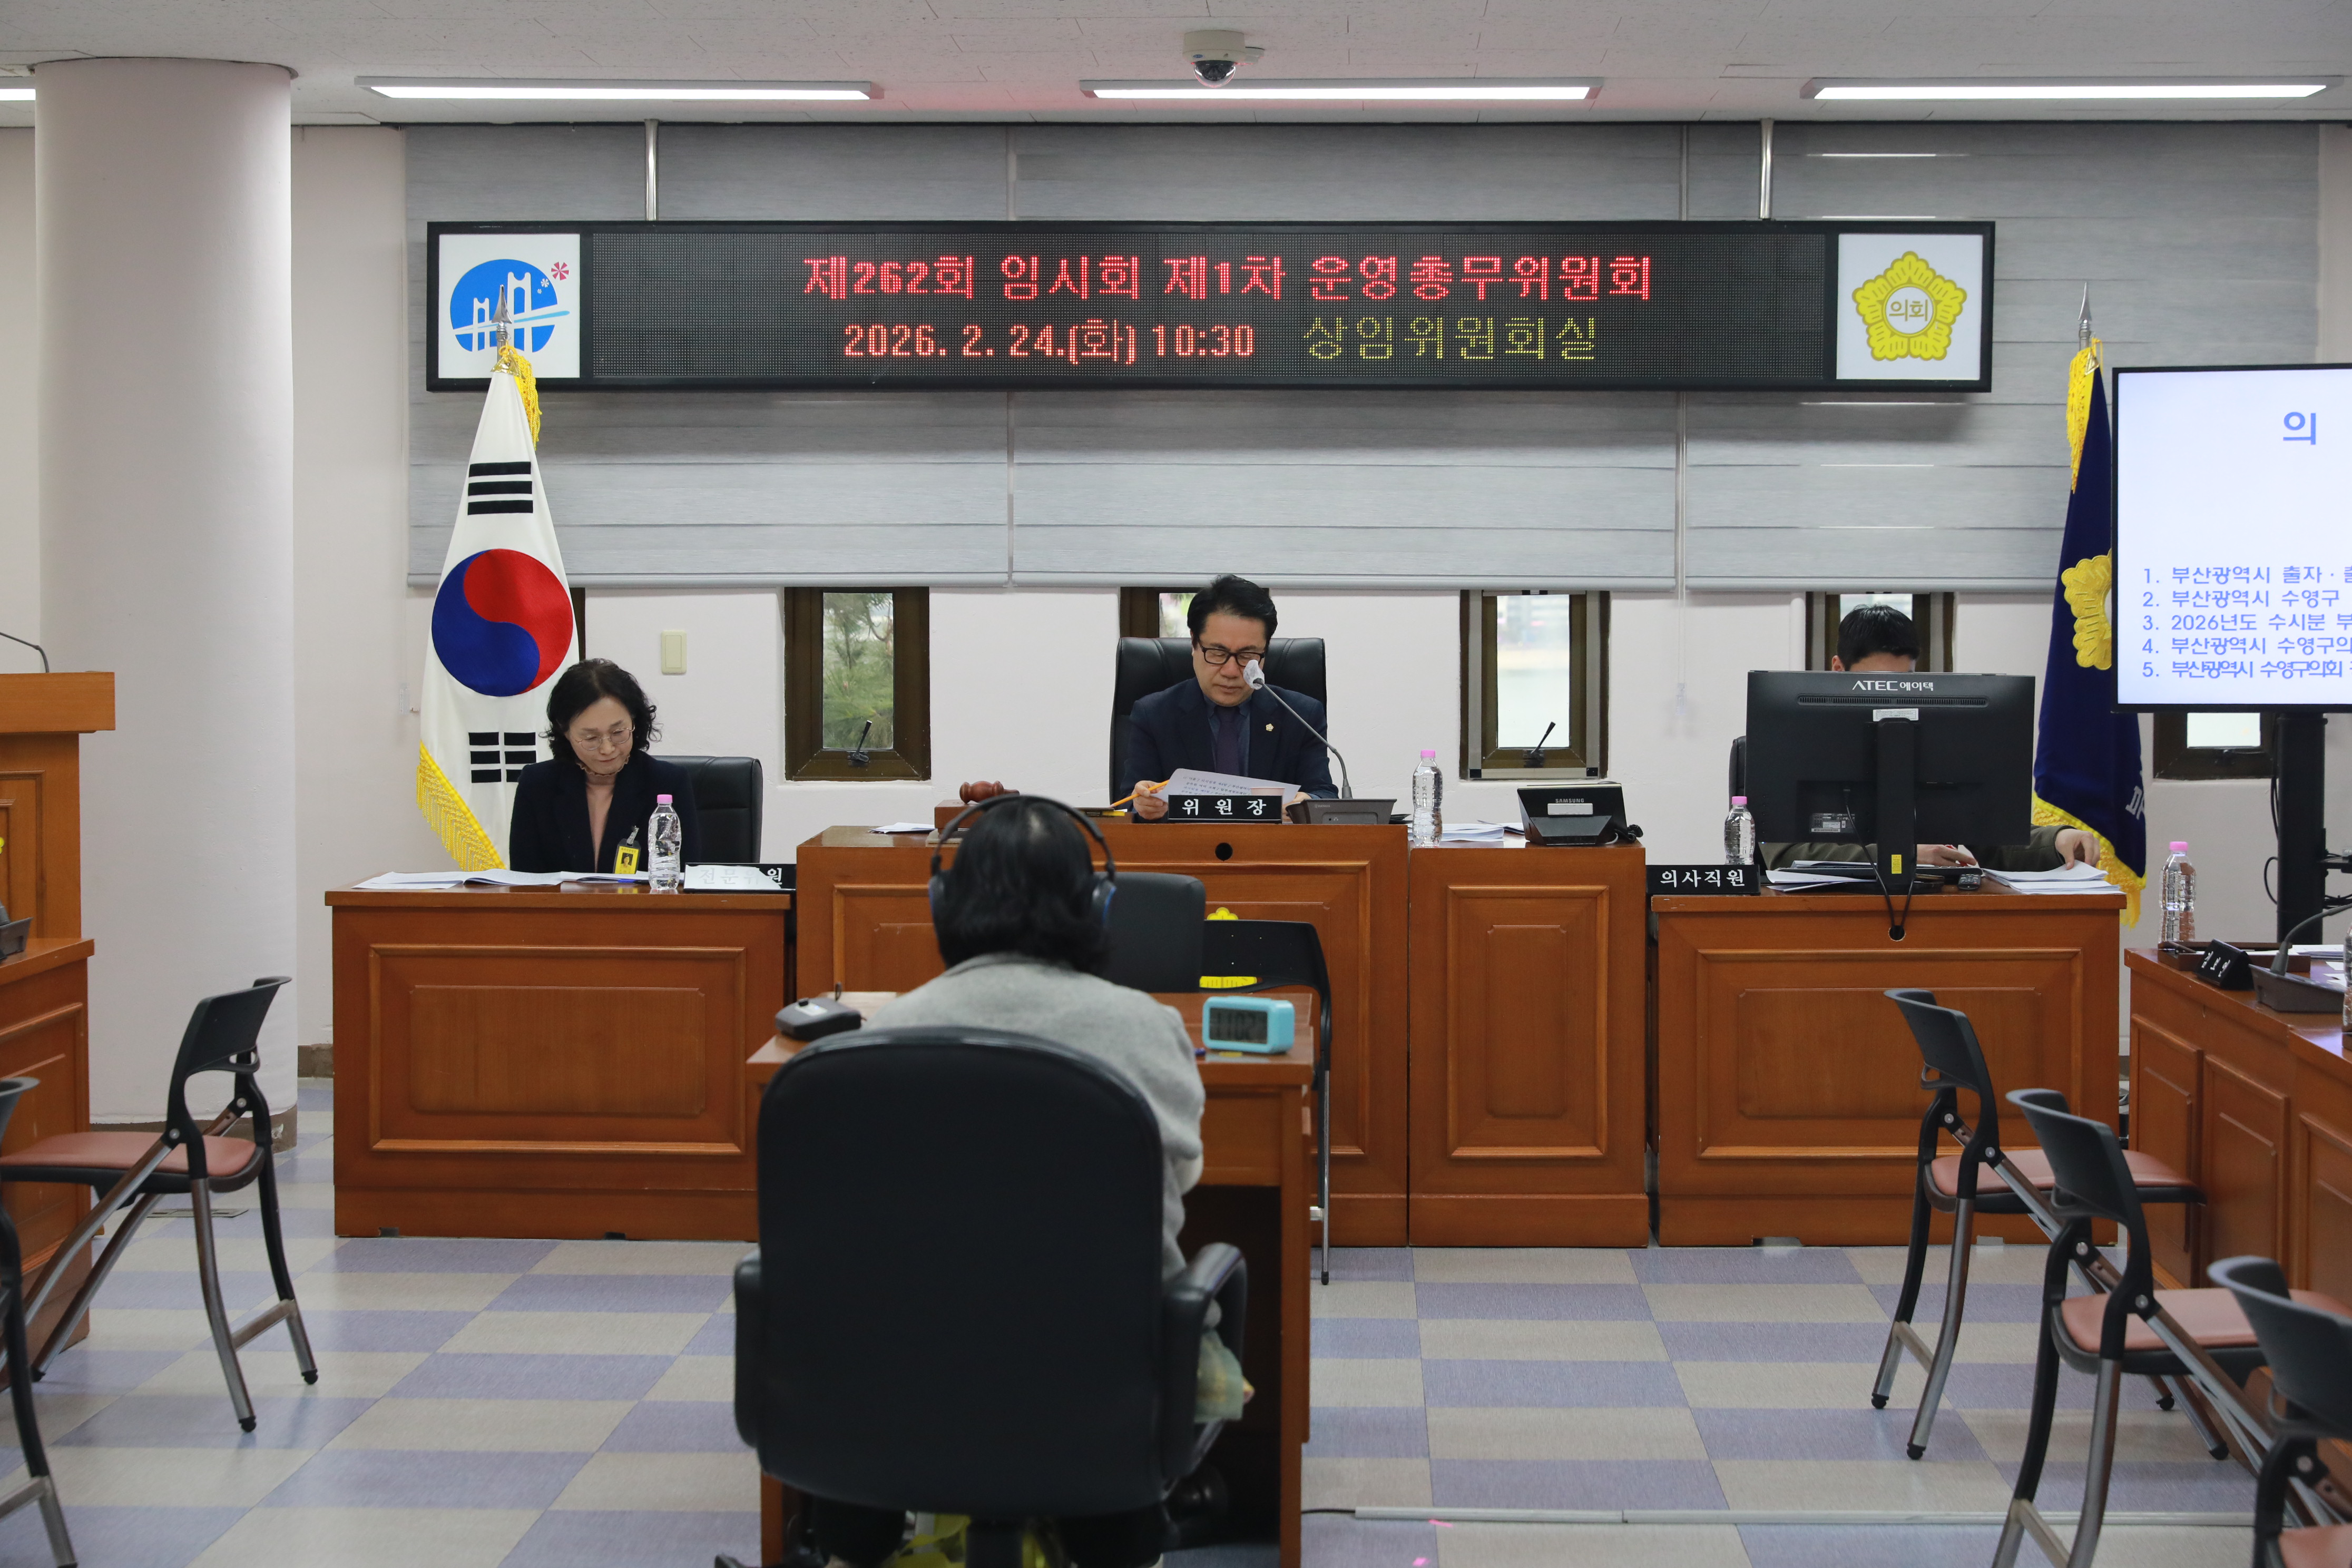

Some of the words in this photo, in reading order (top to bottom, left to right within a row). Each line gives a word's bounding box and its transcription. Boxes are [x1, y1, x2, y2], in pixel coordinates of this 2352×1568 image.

[803, 256, 974, 299] 제262회
[1001, 255, 1139, 300] 임시회
[1163, 256, 1287, 300] 제1차
[1309, 256, 1651, 300] 운영총무위원회
[1889, 299, 1928, 321] 의회
[844, 324, 947, 357] 2026.
[962, 324, 995, 357] 2.
[1008, 318, 1136, 365] 24.(화)
[1152, 324, 1254, 357] 10:30
[1303, 317, 1595, 359] 상임위원회실
[2282, 411, 2316, 445] 의
[2144, 568, 2160, 584] 1.
[2172, 566, 2270, 585] 부산광역시
[2142, 591, 2160, 607] 2.
[2172, 590, 2269, 609] 부산광역시
[2281, 590, 2340, 609] 수영구
[2142, 615, 2159, 631] 3.
[2171, 614, 2257, 632] 2026년도
[2268, 613, 2326, 631] 수시분
[2142, 638, 2159, 654] 4.
[2171, 636, 2266, 655] 부산광역시
[2142, 661, 2160, 678] 5.
[2171, 660, 2253, 679] 부산광역시
[2260, 660, 2343, 680] 수영구의회
[1899, 682, 1934, 691] 에이텍
[699, 867, 782, 885] 전문위원
[1660, 869, 1745, 888] 의사직원
